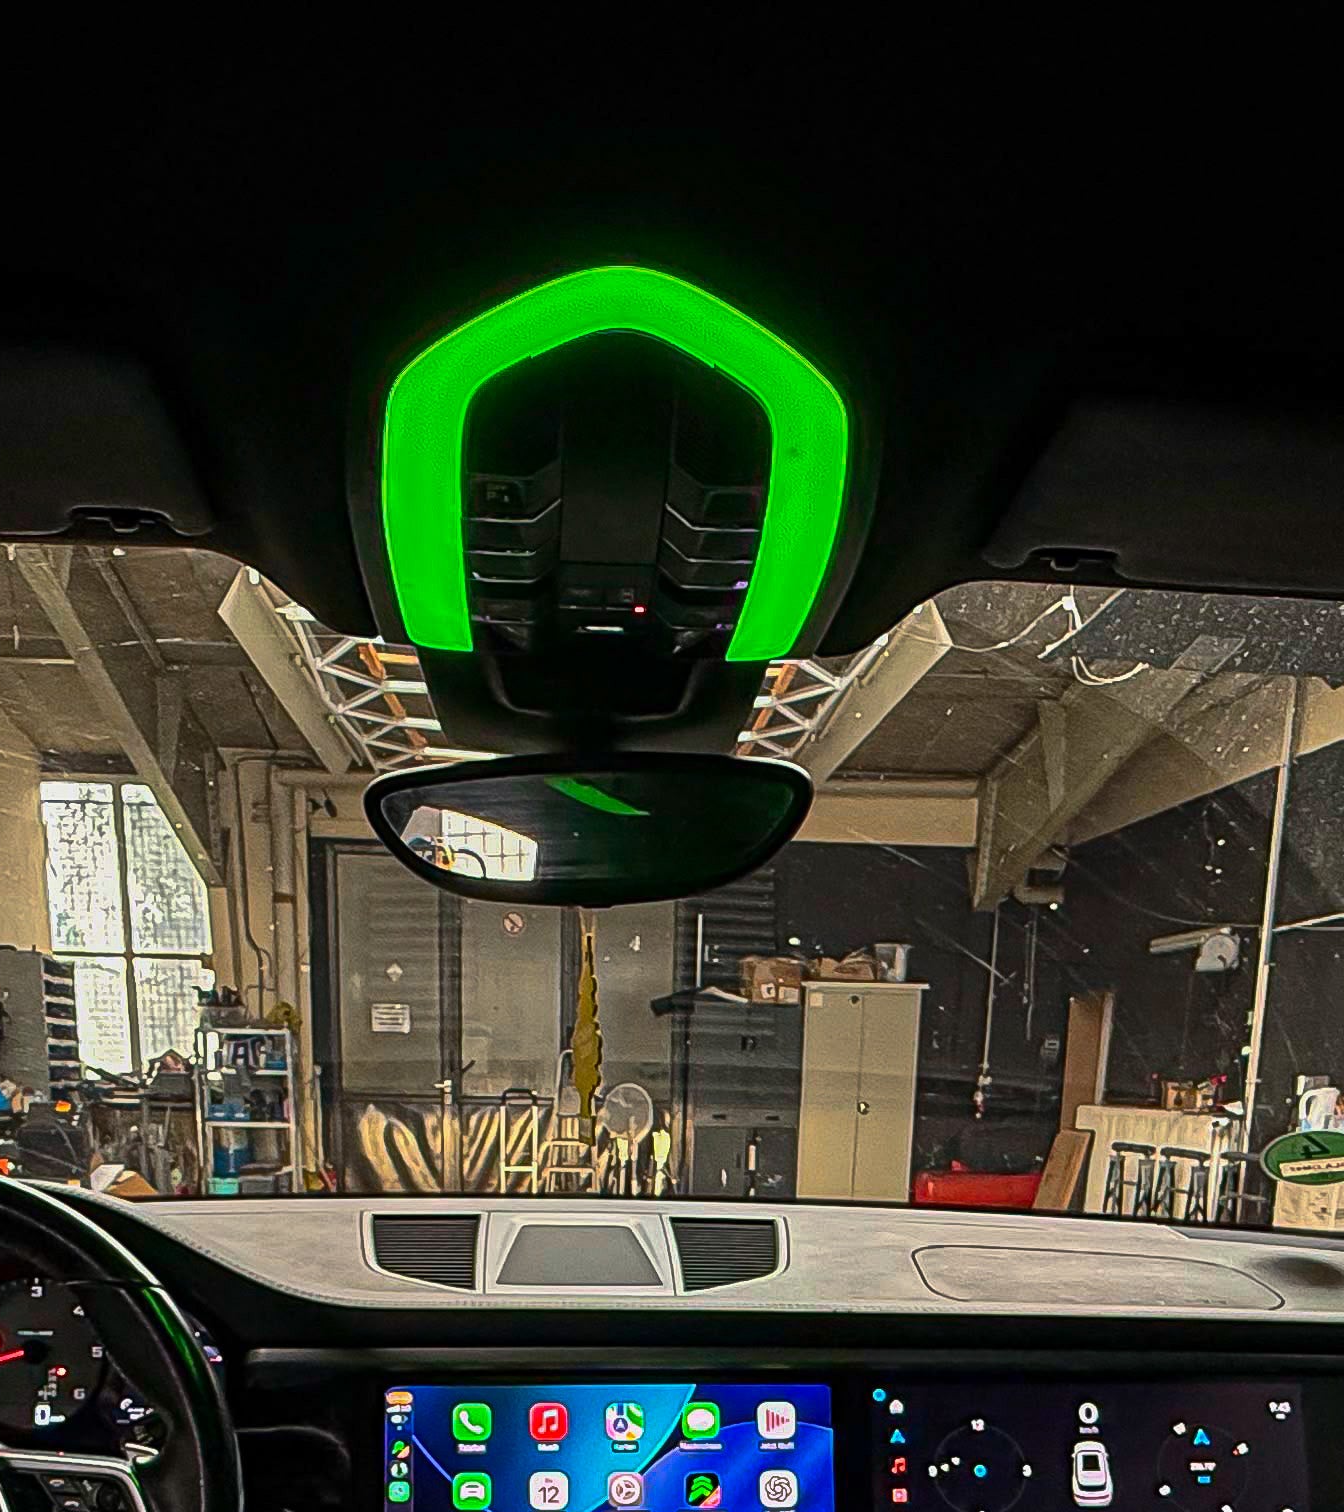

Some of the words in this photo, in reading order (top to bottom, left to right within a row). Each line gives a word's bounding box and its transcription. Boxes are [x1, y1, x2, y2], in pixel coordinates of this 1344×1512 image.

[31, 1286, 43, 1298] 3
[73, 1305, 85, 1317] 4
[91, 1346, 103, 1358] 5
[1078, 1402, 1099, 1424] 0
[538, 1486, 560, 1504] 12
